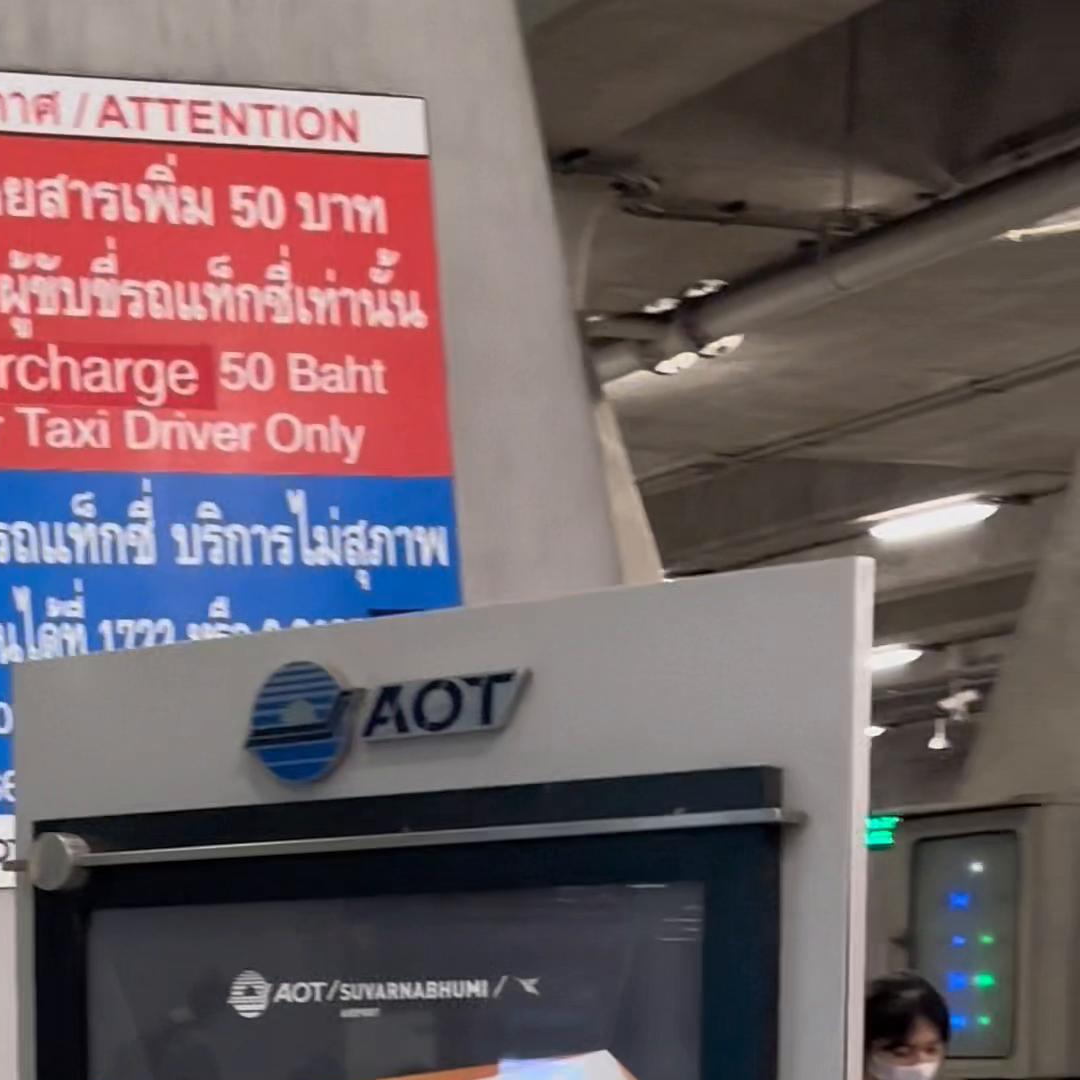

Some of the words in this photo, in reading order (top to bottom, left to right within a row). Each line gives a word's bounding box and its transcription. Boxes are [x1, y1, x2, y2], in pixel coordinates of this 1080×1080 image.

[95, 94, 361, 144] ATTENTION
[231, 185, 286, 232] 50
[297, 190, 388, 235] บาท
[220, 352, 275, 393] 50
[287, 353, 389, 396] Baht
[14, 407, 110, 450] Taxi
[125, 410, 255, 454] Driver
[265, 413, 366, 464] Only
[170, 489, 451, 591] บริการไม่สุภาพ
[362, 671, 517, 738] AOT
